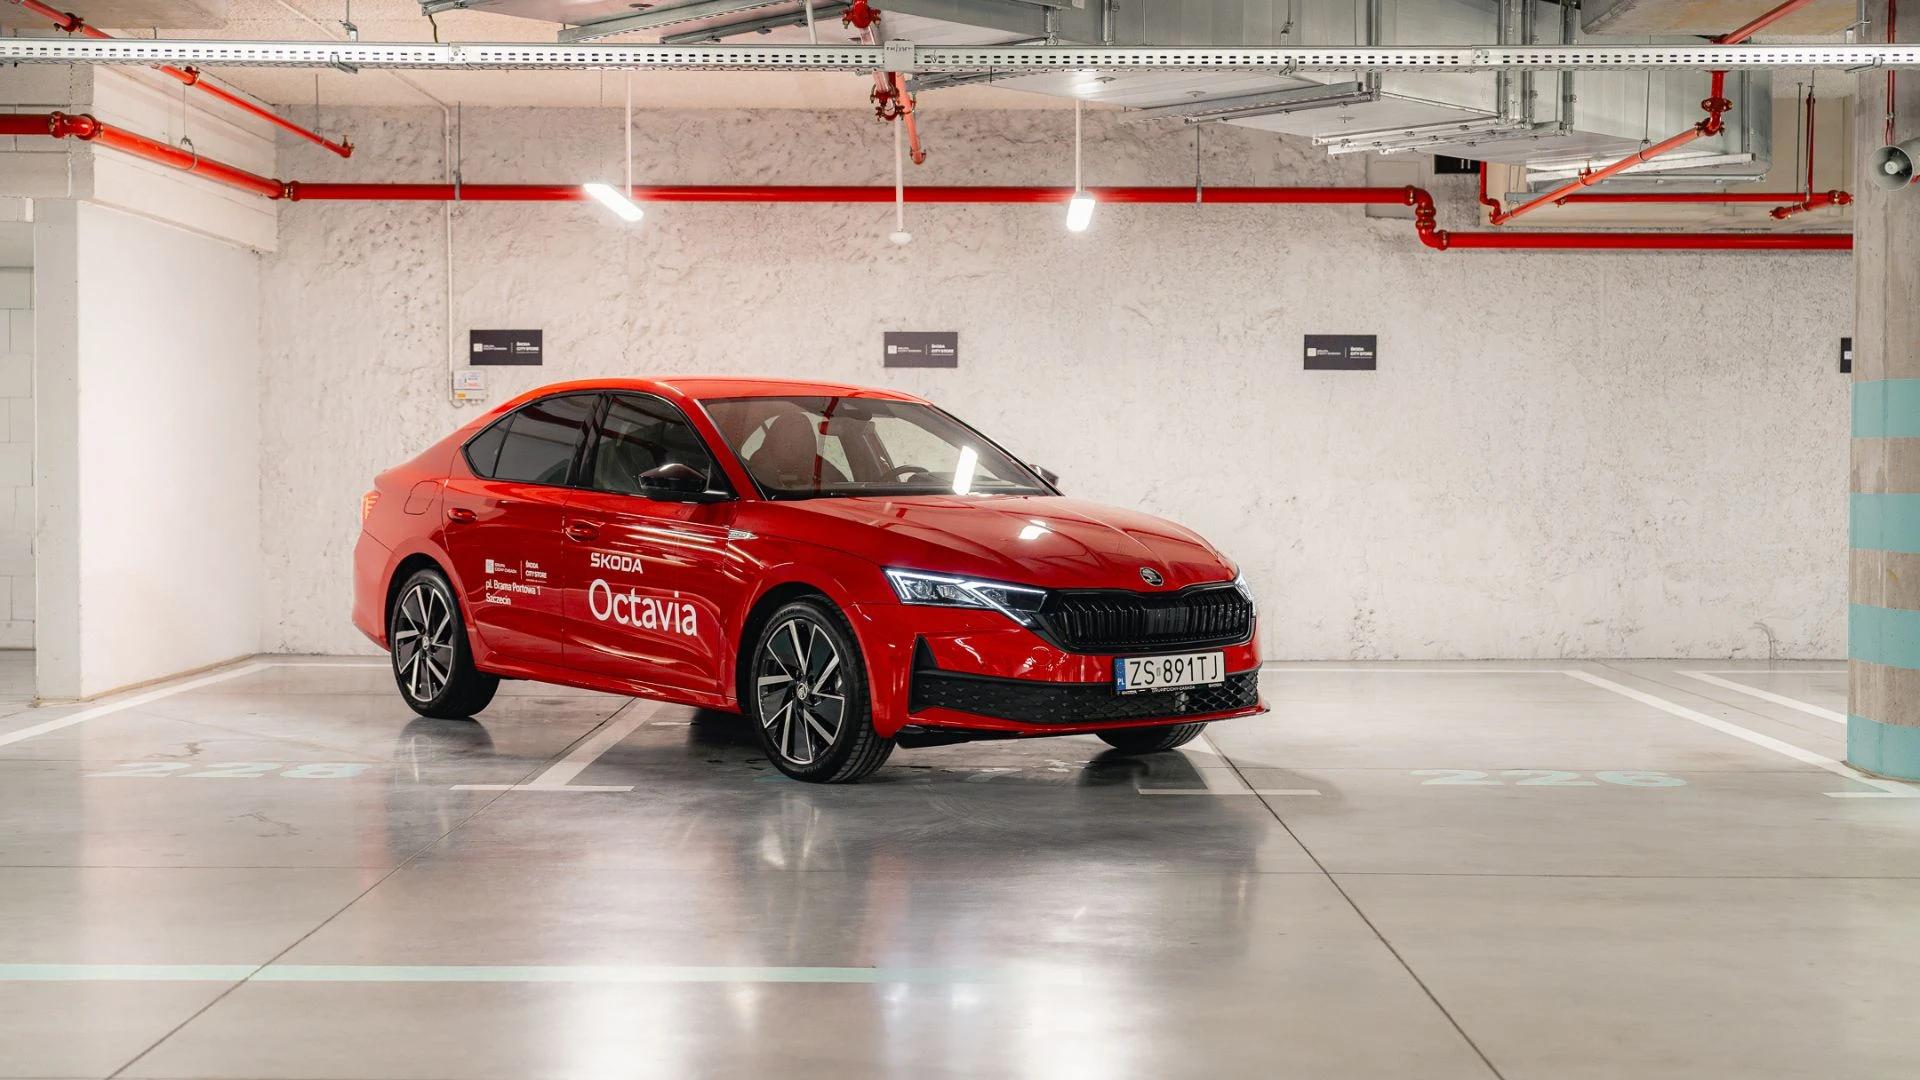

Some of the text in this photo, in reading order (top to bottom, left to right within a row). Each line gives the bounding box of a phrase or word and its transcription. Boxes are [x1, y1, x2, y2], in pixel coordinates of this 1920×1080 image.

[493, 580, 512, 592] Brama
[512, 582, 536, 595] Portowa
[536, 586, 541, 596] 1
[485, 592, 512, 606] Szczecin
[588, 578, 698, 636] Octavia
[1129, 655, 1218, 686] ZS 891TJ
[80, 761, 373, 779] 228
[1408, 768, 1689, 788] 226
